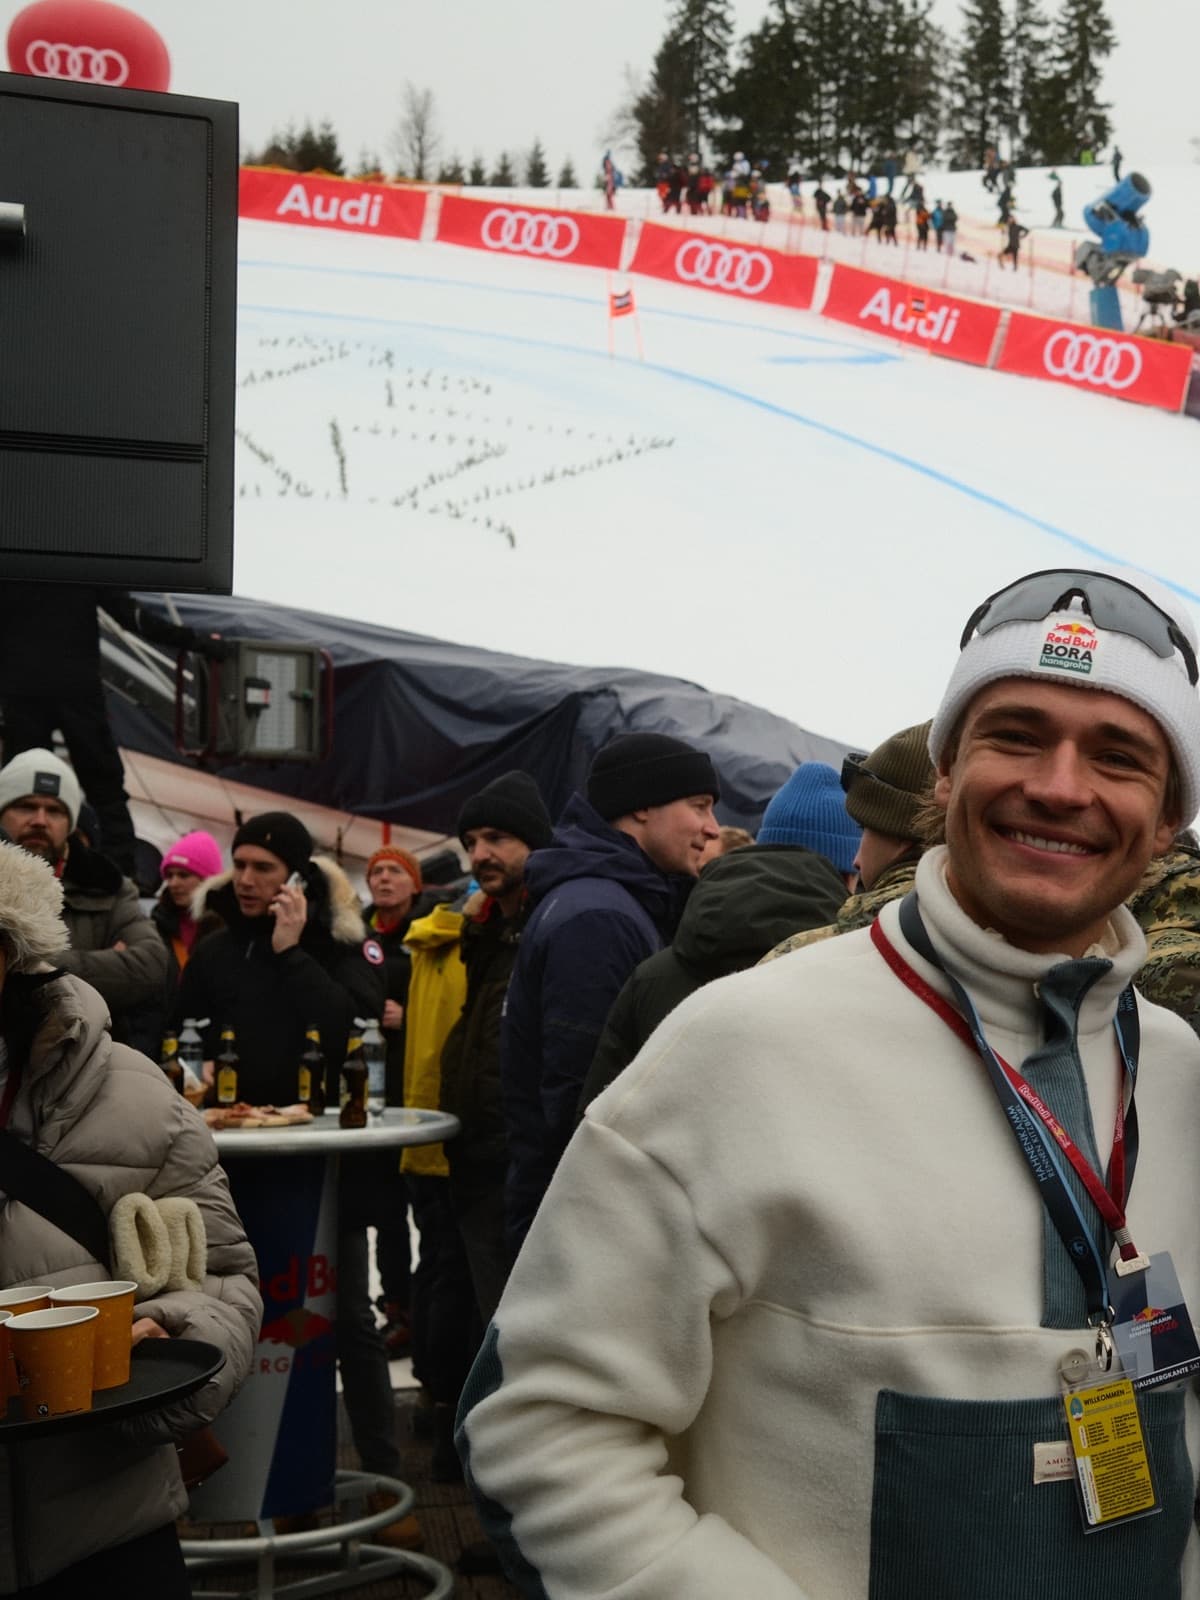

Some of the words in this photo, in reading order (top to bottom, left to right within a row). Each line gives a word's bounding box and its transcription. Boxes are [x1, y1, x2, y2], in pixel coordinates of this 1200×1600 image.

[276, 183, 384, 227] Audi
[859, 287, 960, 344] Audi
[1046, 632, 1072, 645] Red
[1072, 635, 1098, 651] Bull
[1041, 643, 1093, 662] BORA
[1041, 655, 1090, 671] hansgrohe
[1007, 1105, 1047, 1182] HAHNENKAMM
[1034, 1143, 1055, 1178] RENNEN
[1151, 1319, 1179, 1335] 2026
[1134, 1366, 1189, 1389] HAUSBERGKANTE
[1084, 1389, 1125, 1406] WILLKOMMEN
